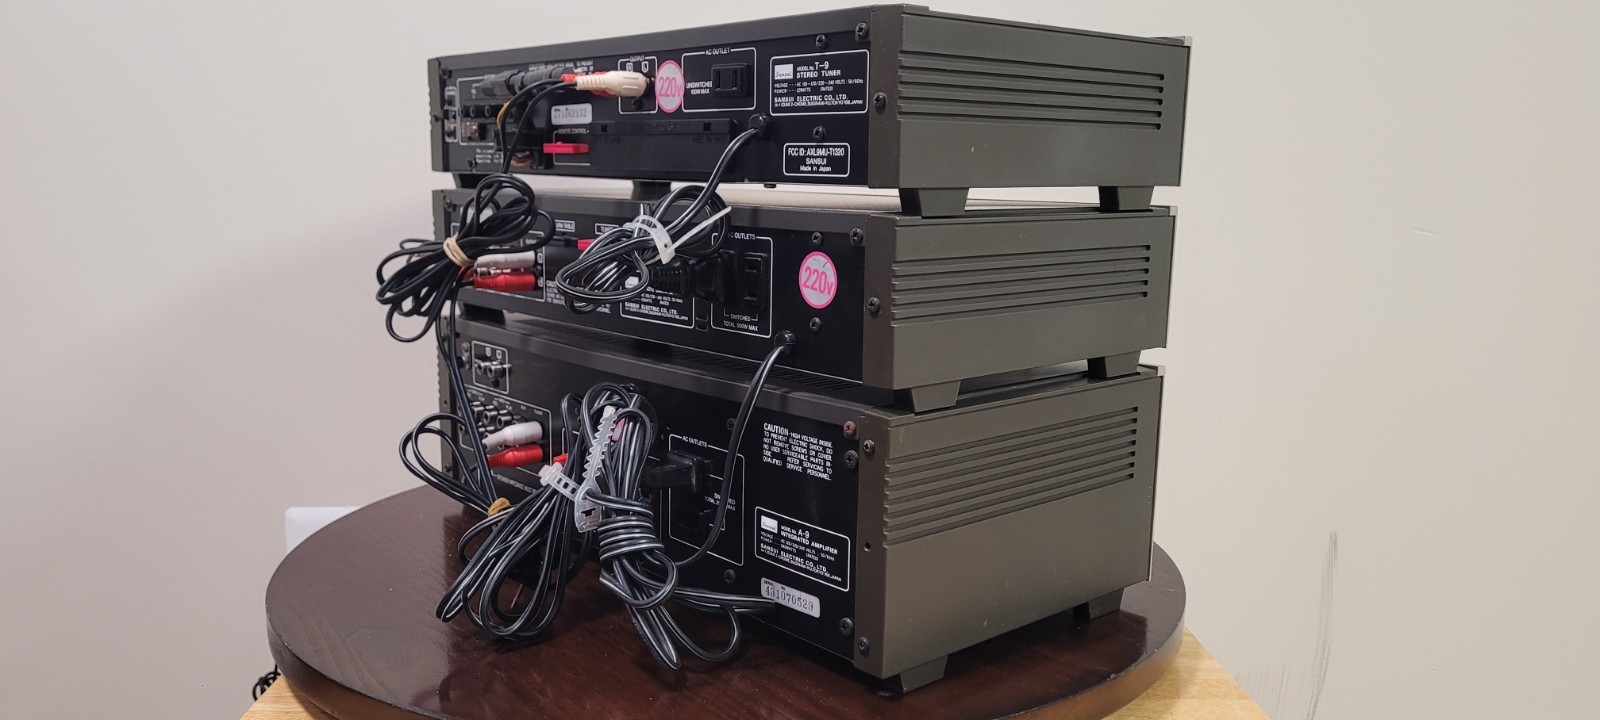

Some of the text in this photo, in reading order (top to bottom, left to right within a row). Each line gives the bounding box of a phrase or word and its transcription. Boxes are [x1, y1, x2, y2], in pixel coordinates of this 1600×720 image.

[814, 60, 830, 70] T-9
[796, 70, 818, 79] STEREO
[788, 147, 799, 156] FCC
[734, 232, 756, 241] OUTLETS
[641, 304, 660, 312] ELECTRIC
[730, 313, 751, 322] SWITCHED
[723, 320, 736, 328] TOTAL
[748, 324, 759, 332] MAX
[688, 437, 708, 448] OUTLETS
[770, 433, 788, 442] PREVENT
[788, 437, 808, 448] ELECTRIC
[801, 435, 818, 444] VOLTAGE
[773, 440, 789, 450] REMOVE
[791, 445, 808, 455] SCREWS
[770, 445, 780, 454] USER
[782, 449, 808, 462] SERVICEABLE
[810, 457, 824, 466] PARTS
[762, 456, 782, 466] QUALIFIED
[786, 463, 803, 473] SERVICE
[786, 456, 800, 465] REFER
[802, 461, 824, 472] SERVICING
[781, 525, 792, 533] MODEL
[798, 528, 810, 539] A-9
[780, 530, 838, 555] INTEGRATED AMPLIFIER
[760, 543, 779, 555] SANSUI
[780, 550, 804, 564] ELECTRIC
